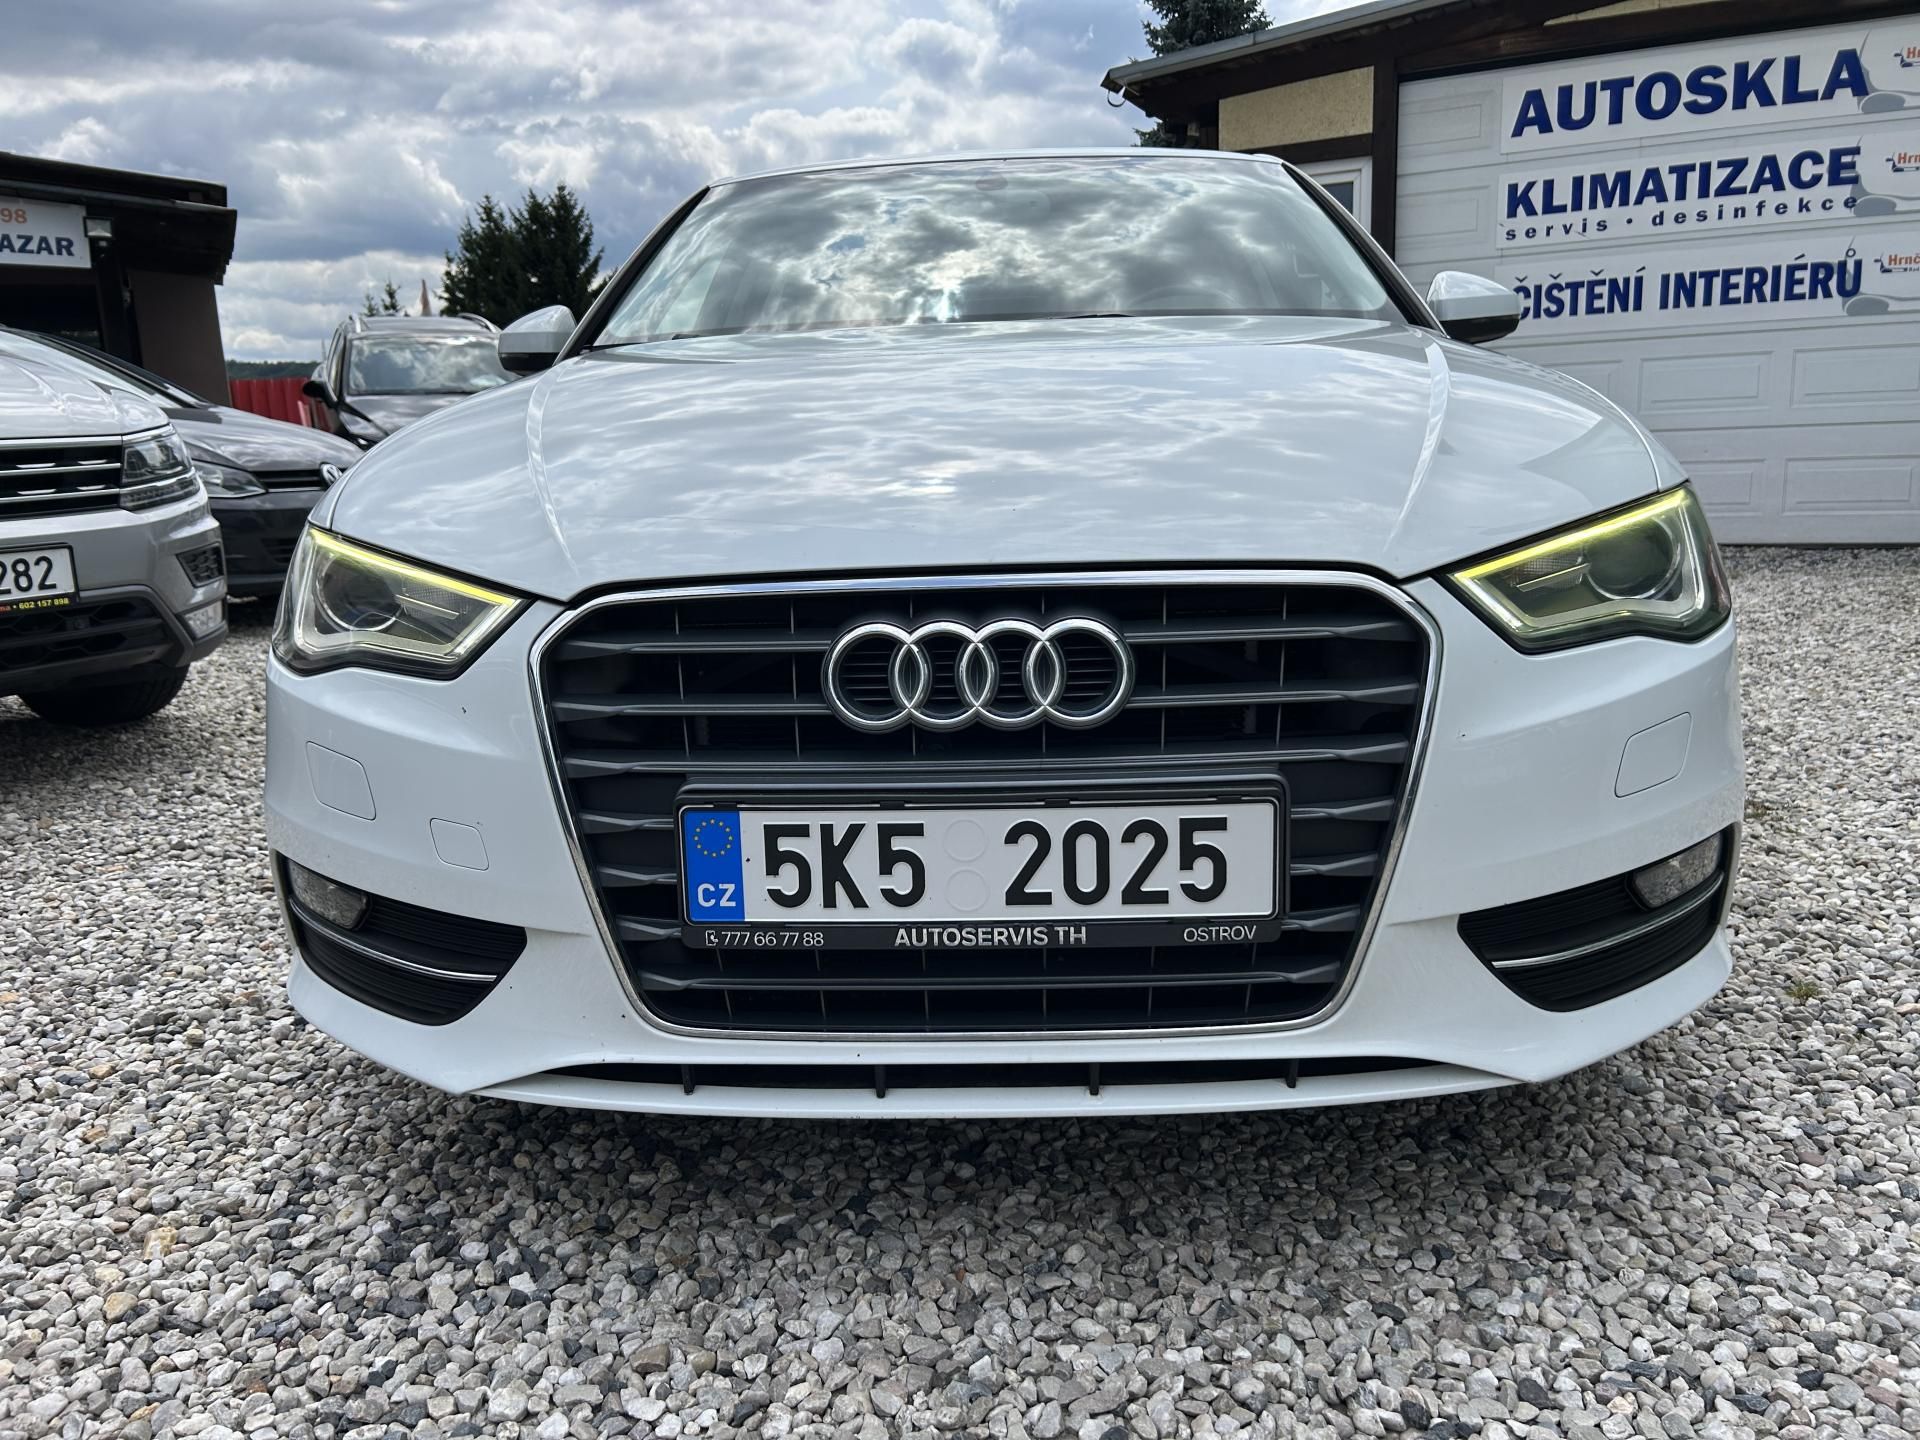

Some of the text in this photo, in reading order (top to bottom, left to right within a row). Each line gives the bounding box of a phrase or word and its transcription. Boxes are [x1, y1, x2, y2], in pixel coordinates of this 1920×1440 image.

[1511, 48, 1869, 138] AUTOSKLA
[1506, 146, 1861, 218] KLIMATIZACE
[0, 207, 27, 224] 98
[1505, 196, 1858, 241] servis desinfekce
[0, 233, 75, 256] AZAR
[1513, 247, 1863, 320] ČIŠTĚNÍ INTERIÉRŮ
[763, 815, 1228, 909] 5K5 2025
[697, 883, 736, 907] CZ
[721, 925, 1257, 947] 777 66 77 88 AUTOSERVIS TH OSTROV
